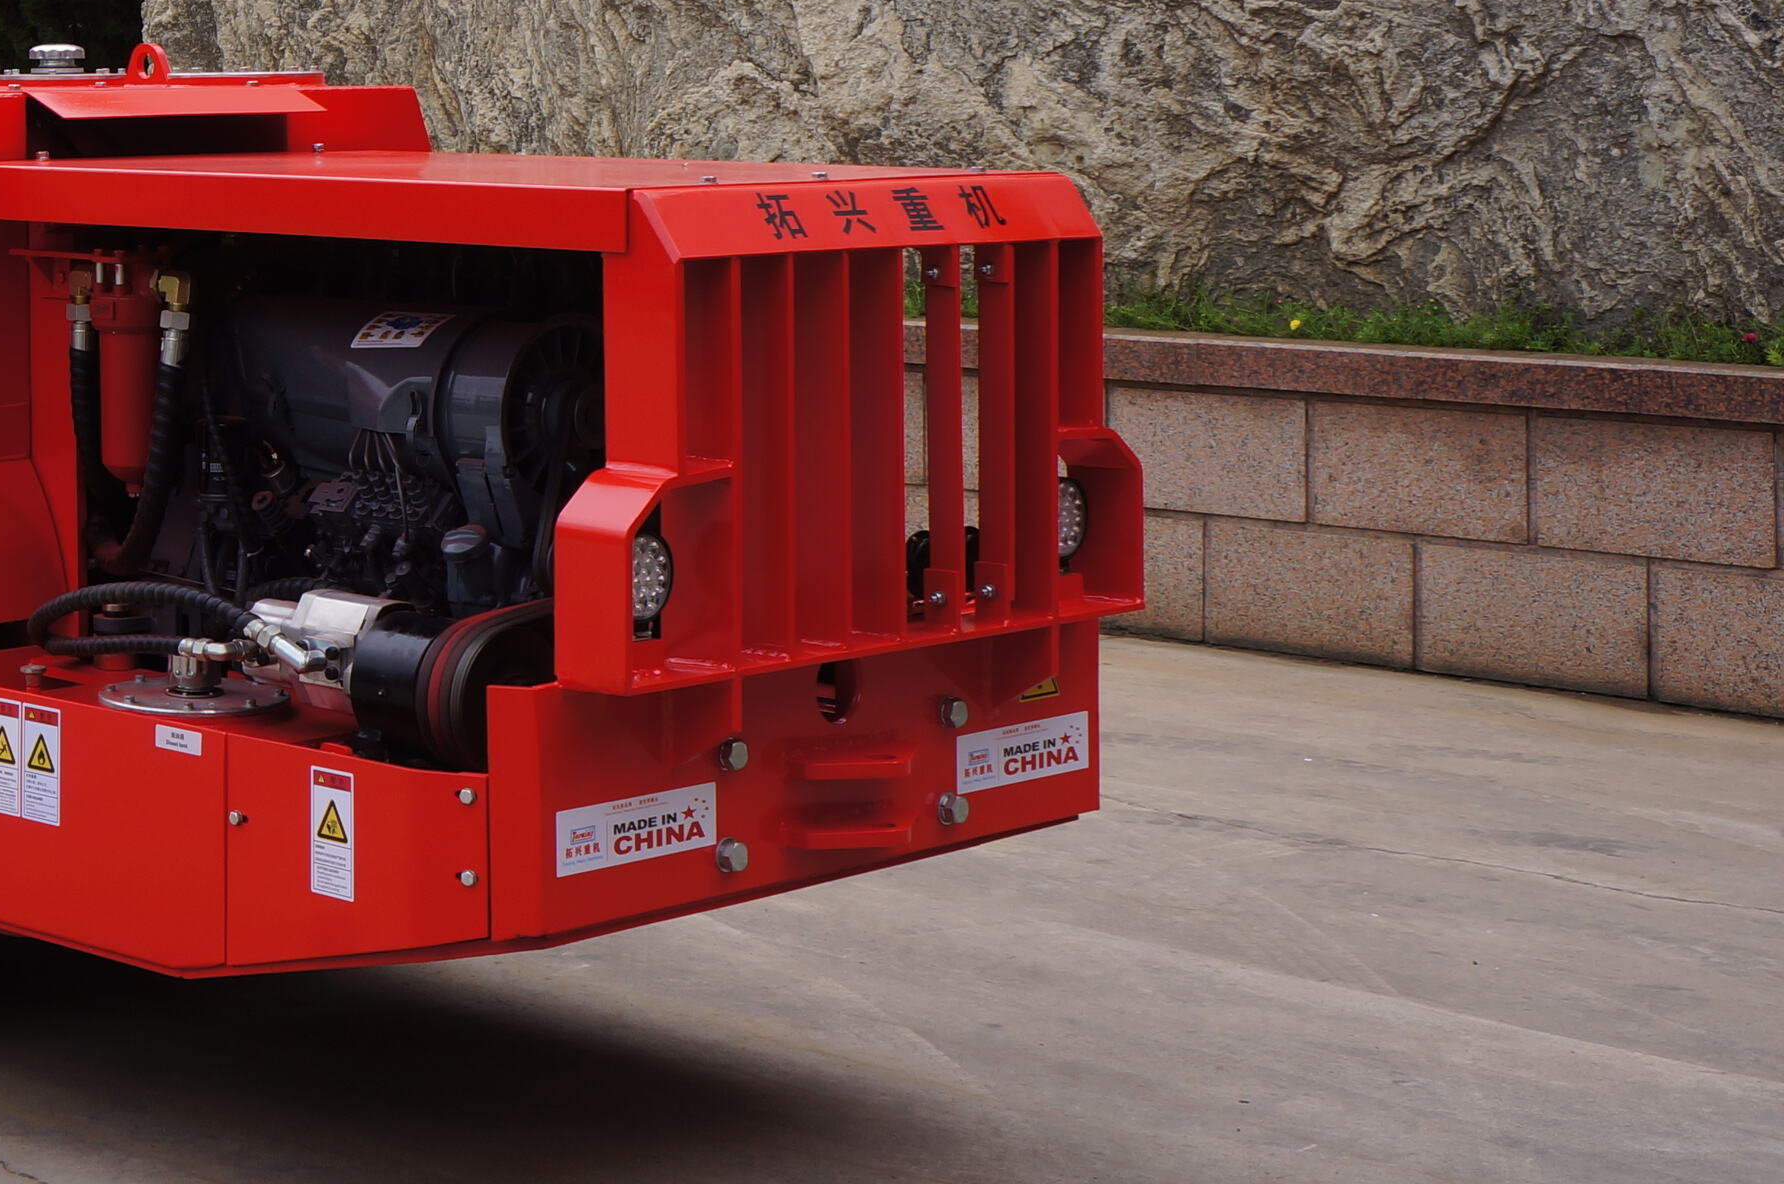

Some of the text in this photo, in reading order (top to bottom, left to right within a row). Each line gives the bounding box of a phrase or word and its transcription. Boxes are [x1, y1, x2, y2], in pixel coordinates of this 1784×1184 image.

[756, 185, 1007, 241] 拓兴重机
[1003, 741, 1040, 758] MADE
[1043, 737, 1056, 749] IN
[1003, 746, 1080, 776] CHINA
[613, 812, 678, 836] MADE IN
[613, 820, 706, 856] CHINA
